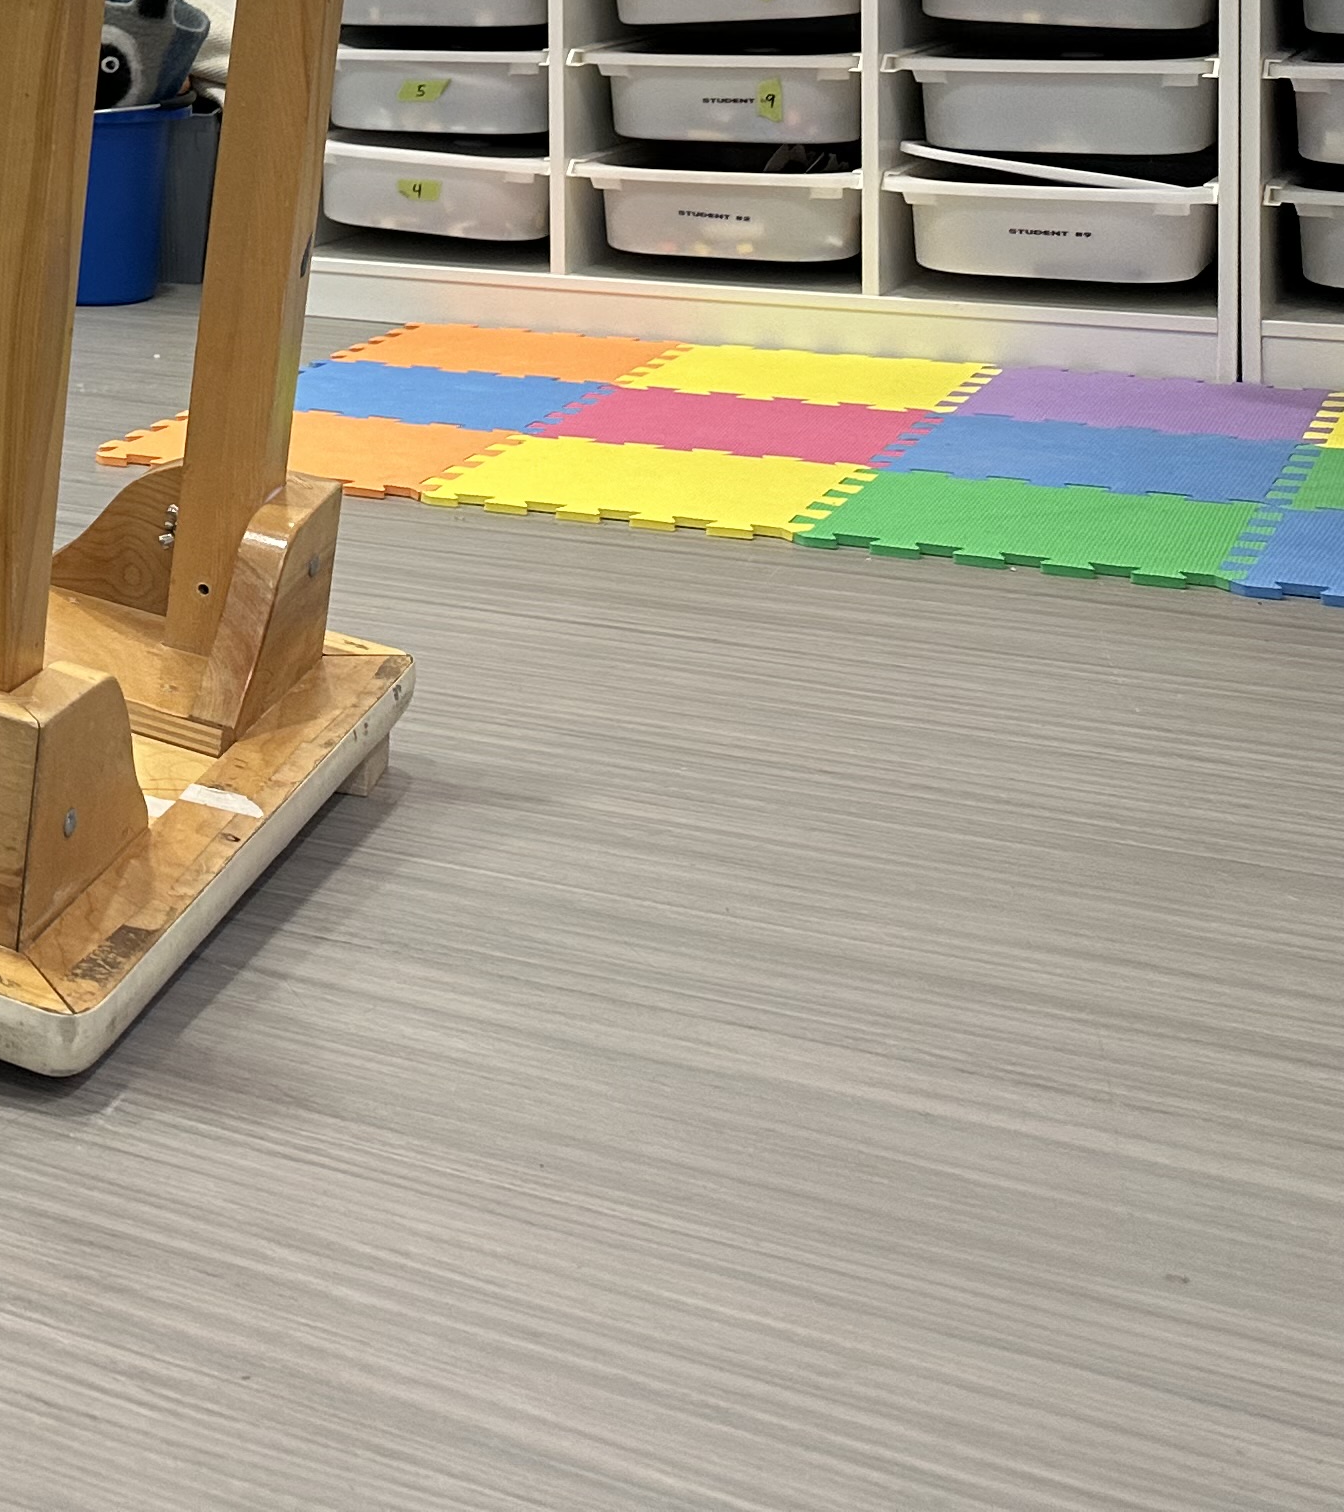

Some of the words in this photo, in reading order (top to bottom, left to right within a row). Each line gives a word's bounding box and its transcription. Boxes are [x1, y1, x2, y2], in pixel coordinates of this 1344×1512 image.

[415, 84, 427, 97] 5
[765, 93, 776, 109] 9
[412, 183, 422, 199] 4
[678, 210, 730, 220] STUDENT
[1008, 228, 1069, 237] STUDENT
